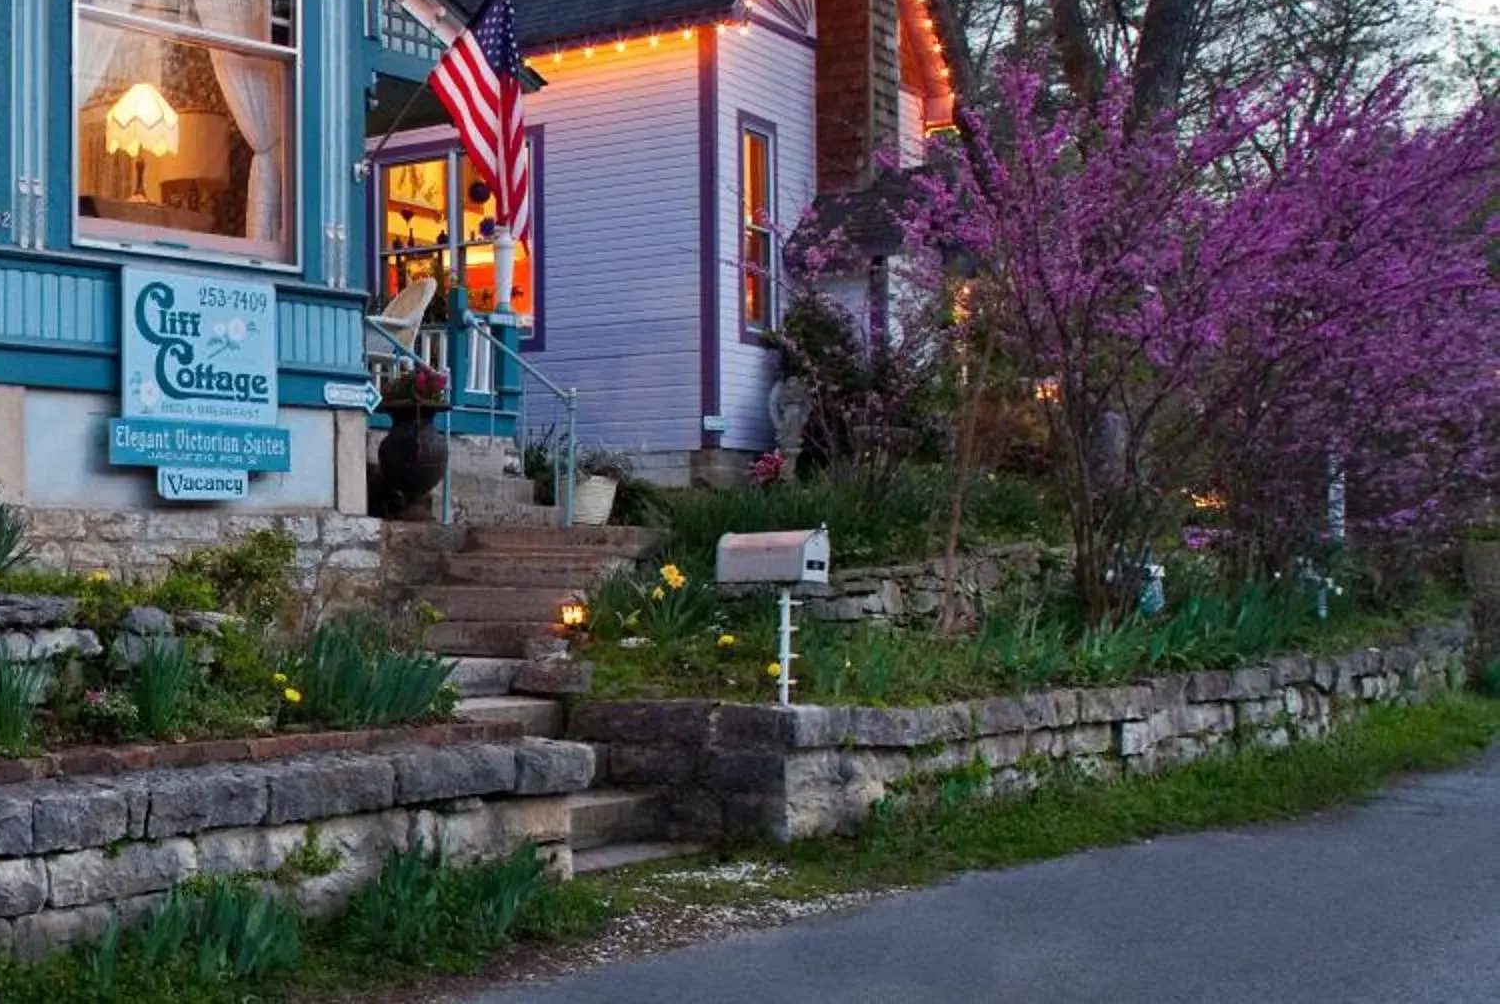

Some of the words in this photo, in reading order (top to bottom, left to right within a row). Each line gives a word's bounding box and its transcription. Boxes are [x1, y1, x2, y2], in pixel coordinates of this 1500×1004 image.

[135, 281, 202, 345] Cliff
[199, 287, 268, 313] 253-7409
[155, 337, 269, 404] Cottage
[115, 425, 170, 453] Elegant
[175, 427, 239, 453] Victorian
[243, 430, 286, 456] Suites
[167, 473, 244, 495] Vacancy
